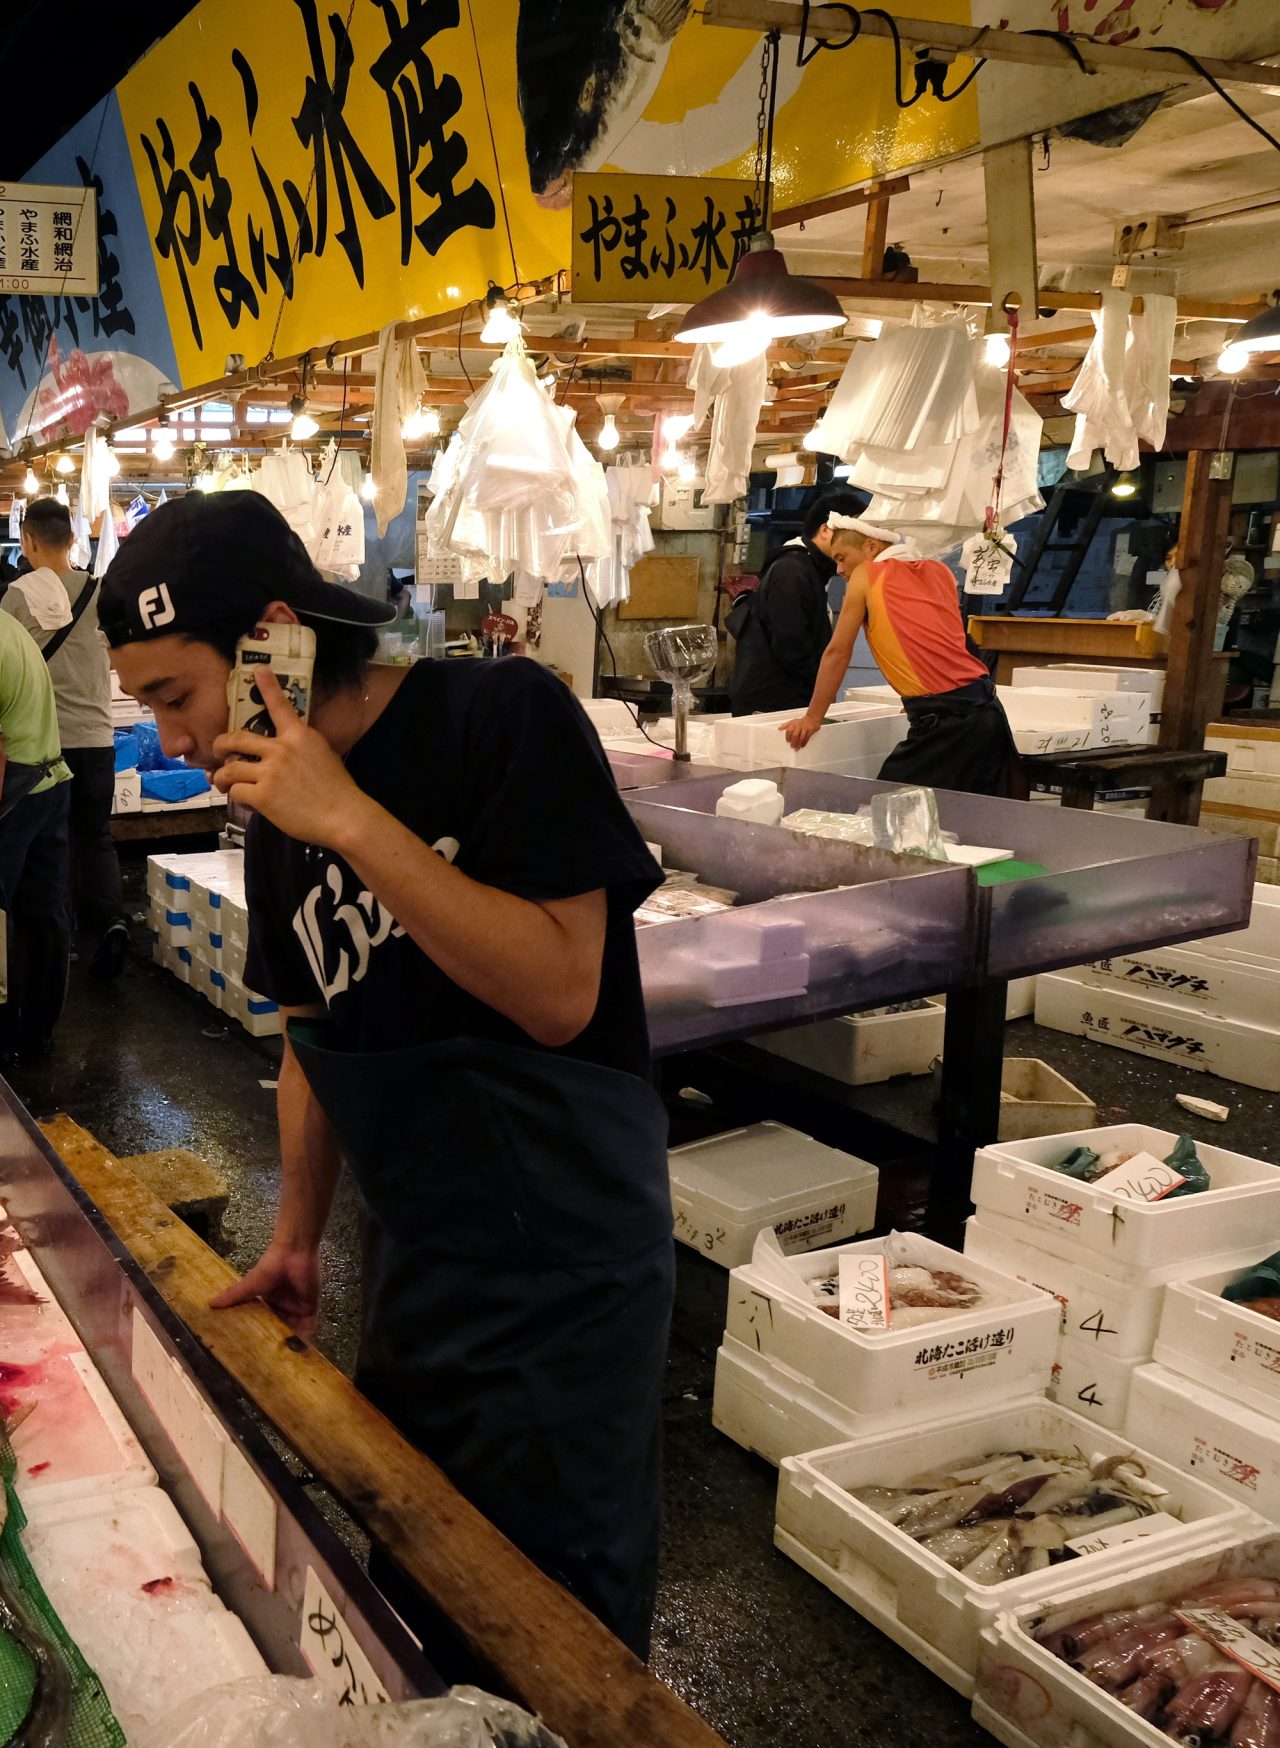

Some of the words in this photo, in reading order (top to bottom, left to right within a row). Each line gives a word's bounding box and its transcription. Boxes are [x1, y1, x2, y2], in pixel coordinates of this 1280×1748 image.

[139, 0, 495, 352] やまふ水産
[20, 208, 40, 271] やまふ水産
[138, 582, 176, 630] FJ
[1079, 1308, 1119, 1341] 4
[1077, 1382, 1104, 1407] 4
